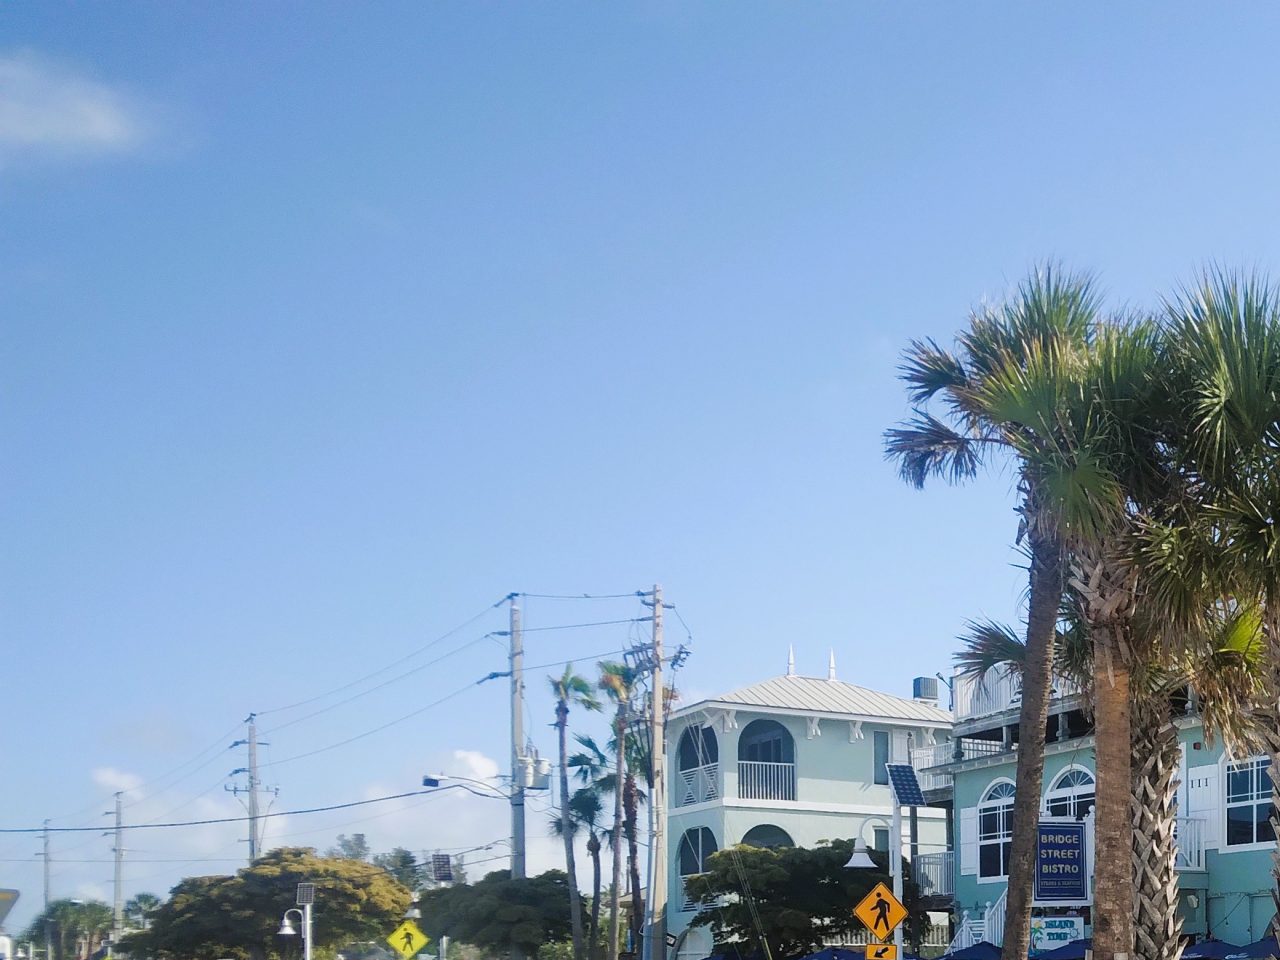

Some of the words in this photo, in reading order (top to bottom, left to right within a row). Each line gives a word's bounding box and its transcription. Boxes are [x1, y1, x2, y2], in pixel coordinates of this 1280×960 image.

[1191, 778, 1208, 788] 111
[1040, 834, 1079, 844] BRIDGE
[1040, 849, 1080, 859] STREET
[1042, 864, 1079, 874] BISTRO
